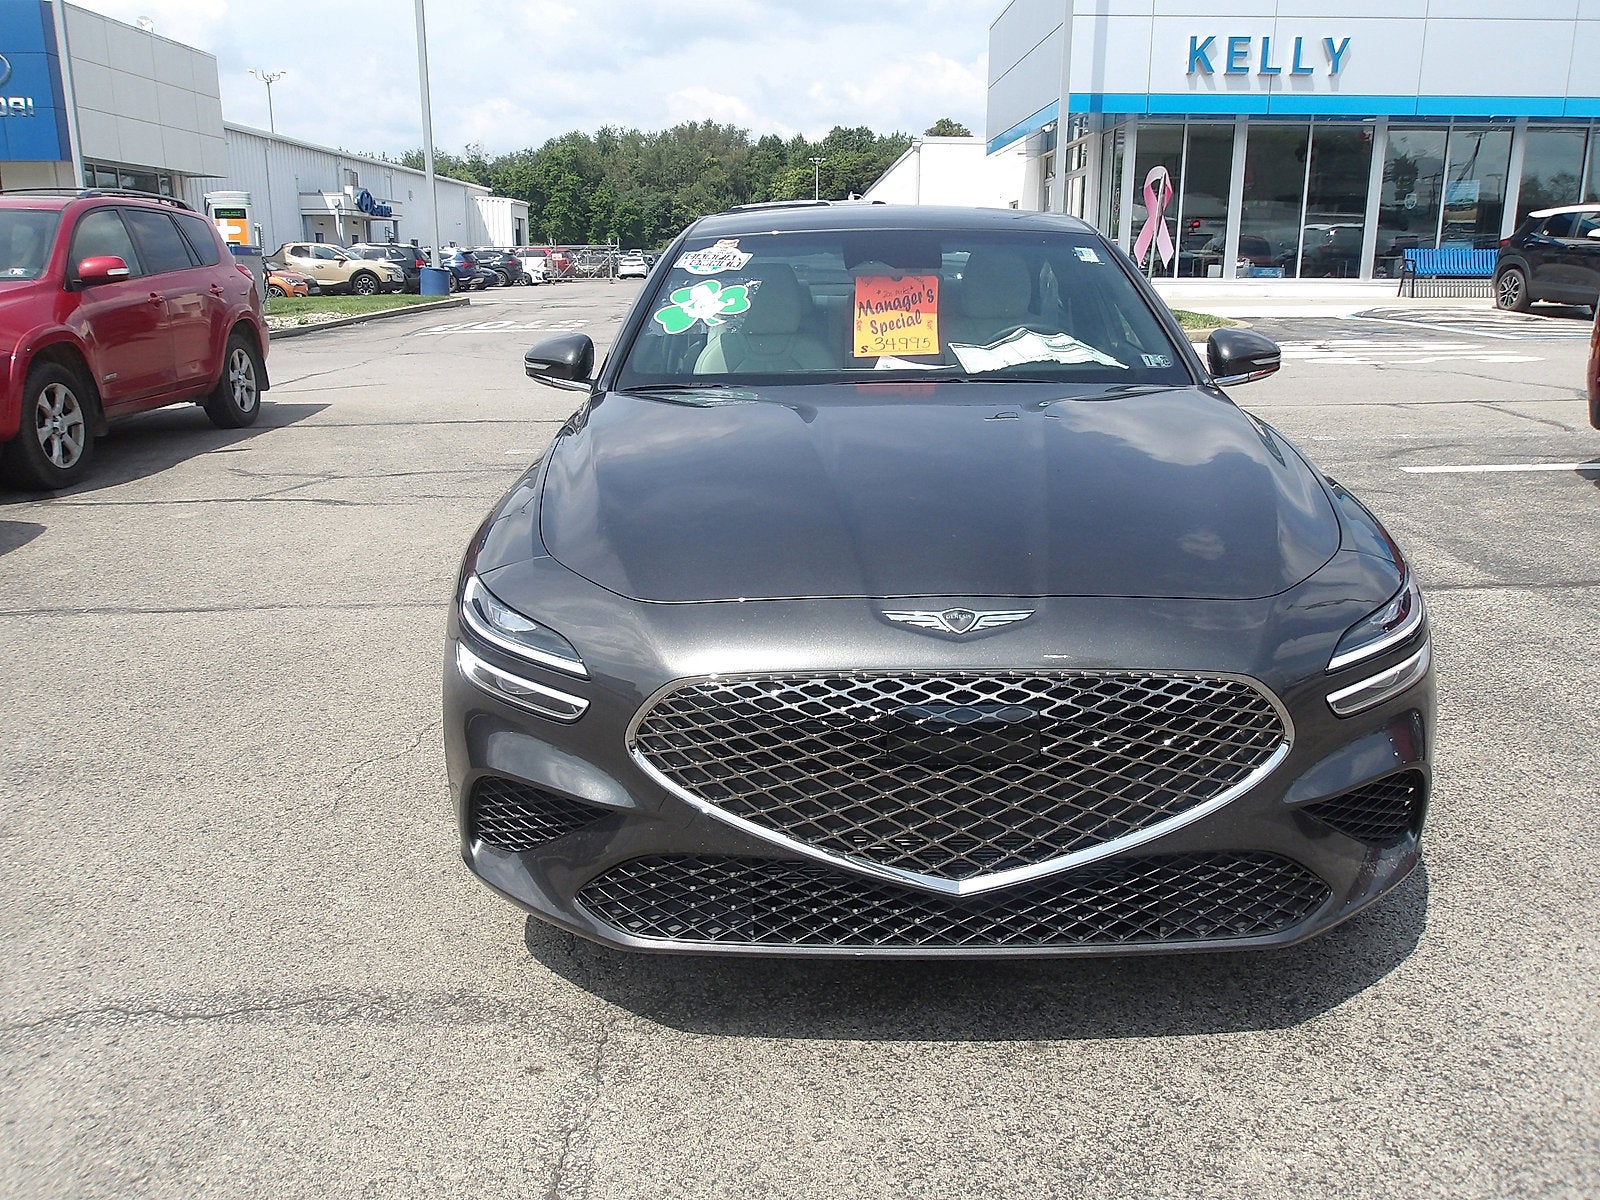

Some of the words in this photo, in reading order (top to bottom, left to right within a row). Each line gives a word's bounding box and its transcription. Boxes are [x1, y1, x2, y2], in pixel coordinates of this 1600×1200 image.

[1186, 35, 1351, 76] KELLY
[858, 284, 935, 318] Manager's
[870, 309, 922, 336] Special
